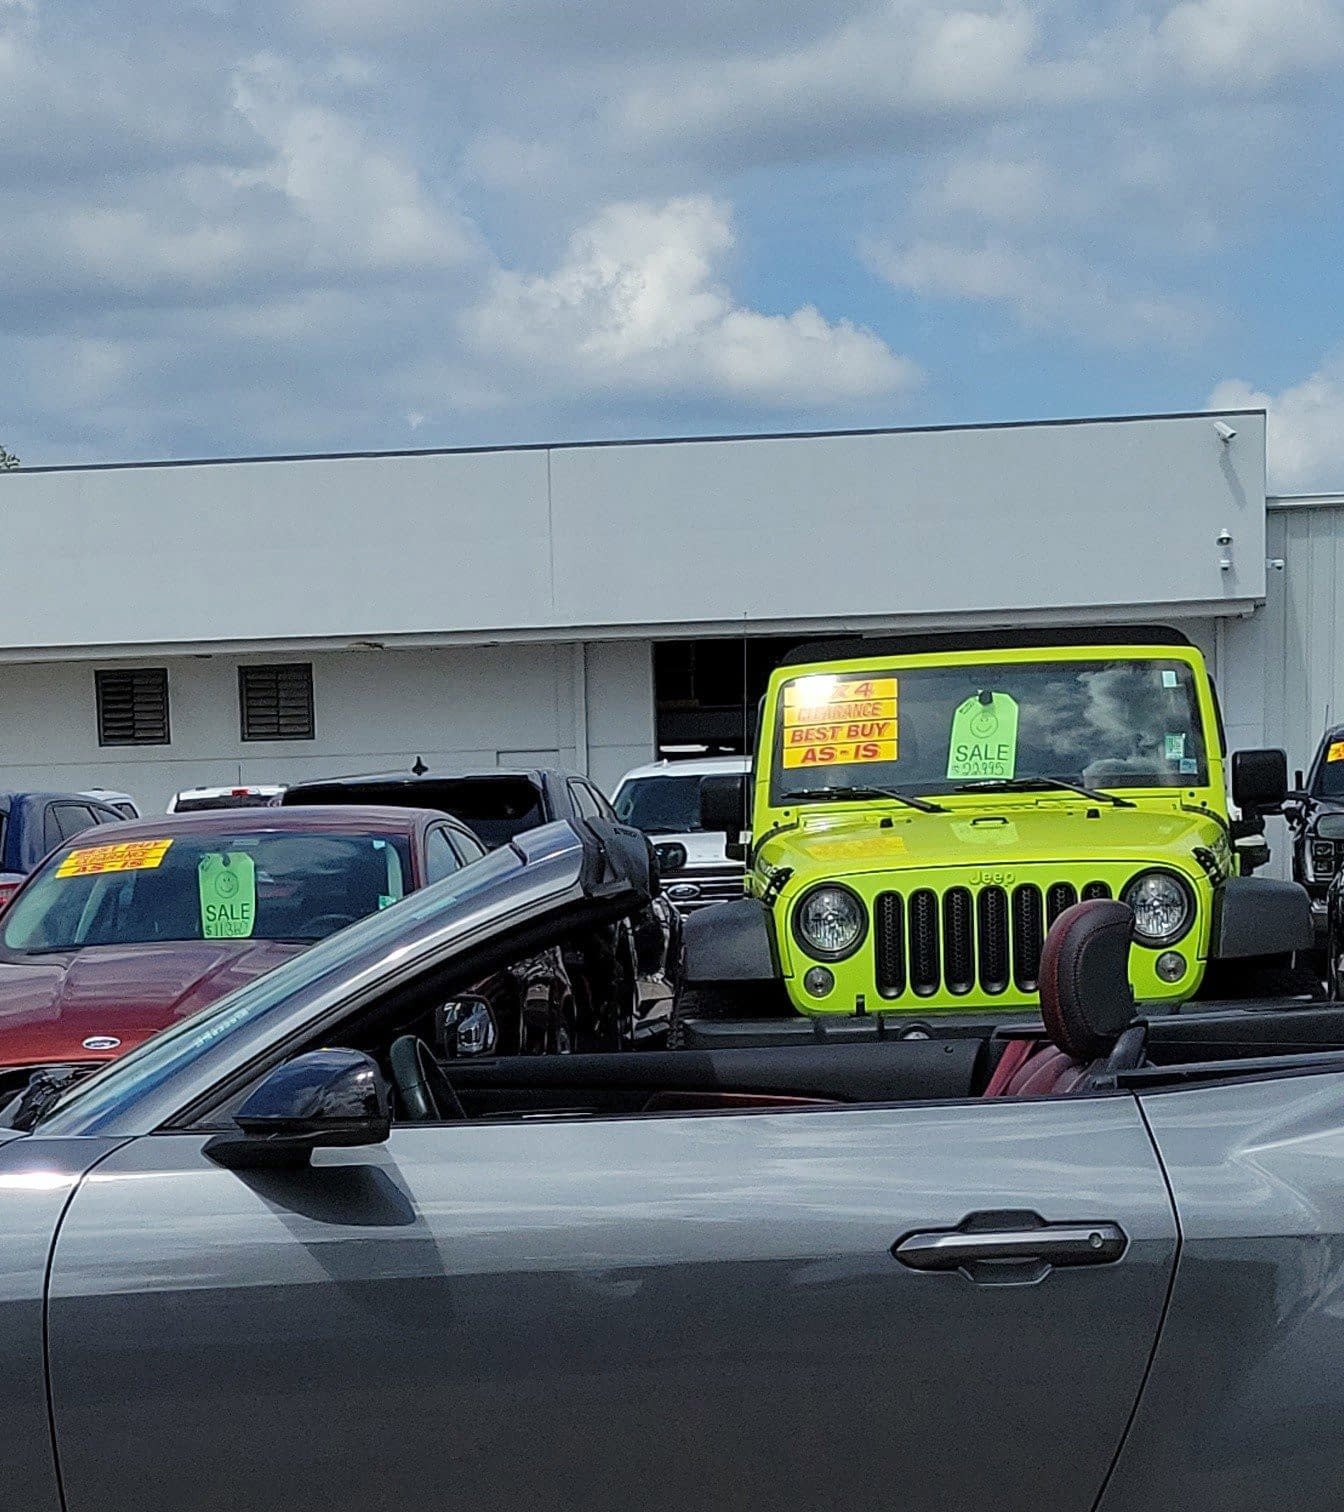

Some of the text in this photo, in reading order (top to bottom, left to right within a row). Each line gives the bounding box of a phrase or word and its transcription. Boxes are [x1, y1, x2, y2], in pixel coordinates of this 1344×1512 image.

[790, 722, 890, 744] BEST BUY
[955, 744, 1010, 762] SALE
[969, 870, 1016, 888] Jeep
[206, 903, 250, 921] SALE
